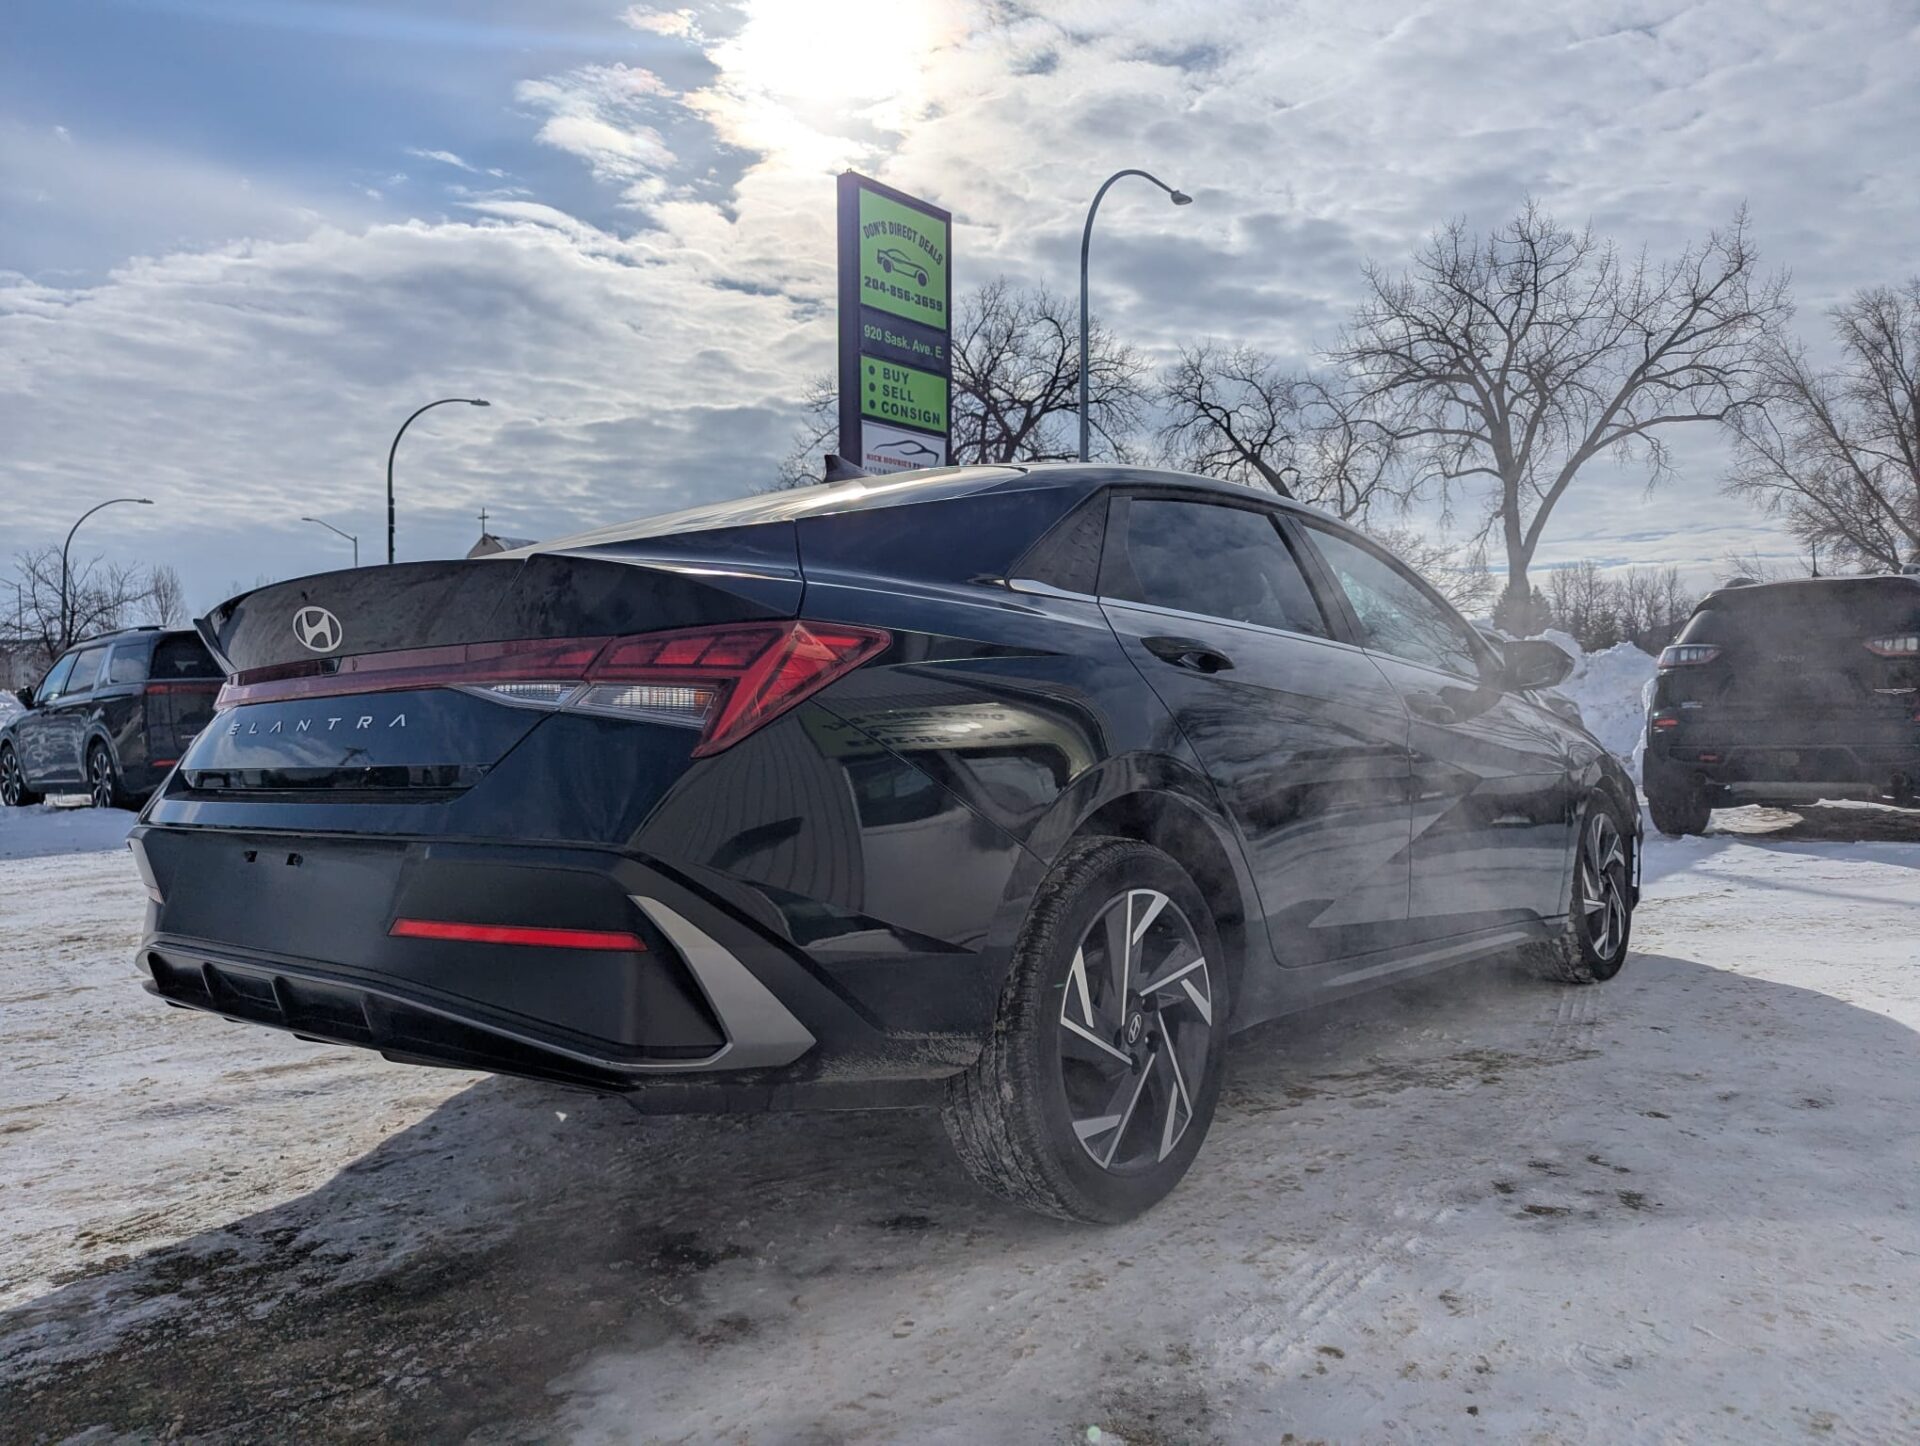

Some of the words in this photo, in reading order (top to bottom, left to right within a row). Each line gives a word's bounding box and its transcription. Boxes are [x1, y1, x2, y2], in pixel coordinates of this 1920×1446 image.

[863, 221, 887, 239] DON'S
[888, 221, 918, 243] DIRECT
[918, 235, 943, 265] DEALS
[864, 275, 943, 312] 204-856-3659
[864, 324, 882, 341] 920
[884, 331, 911, 350] Sask.
[912, 339, 934, 356] Ave.
[935, 346, 945, 359] E.
[883, 367, 909, 385] BUY
[882, 384, 914, 403] SELL
[881, 401, 941, 426] CONSIGN
[228, 713, 407, 736] ELANTRA
